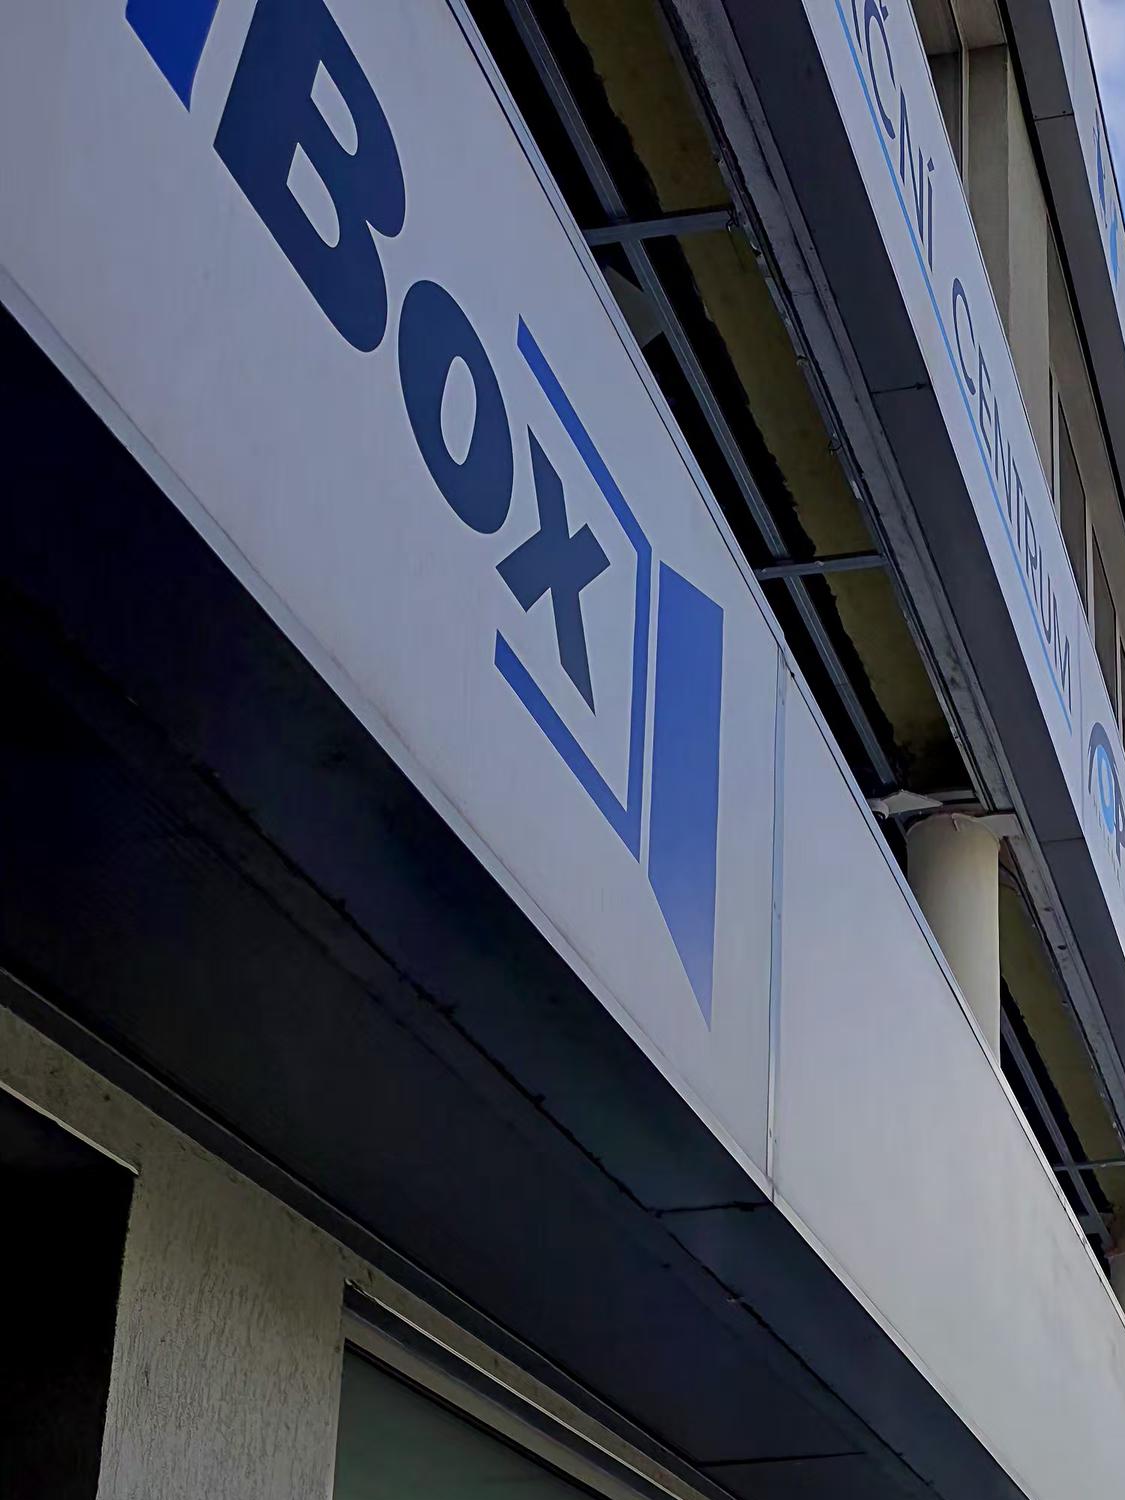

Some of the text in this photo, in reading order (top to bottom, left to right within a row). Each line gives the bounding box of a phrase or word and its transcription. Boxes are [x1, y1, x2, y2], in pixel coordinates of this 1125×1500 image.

[213, 0, 610, 713] Box
[850, 0, 1073, 714] ČNÍ CENTRUM
